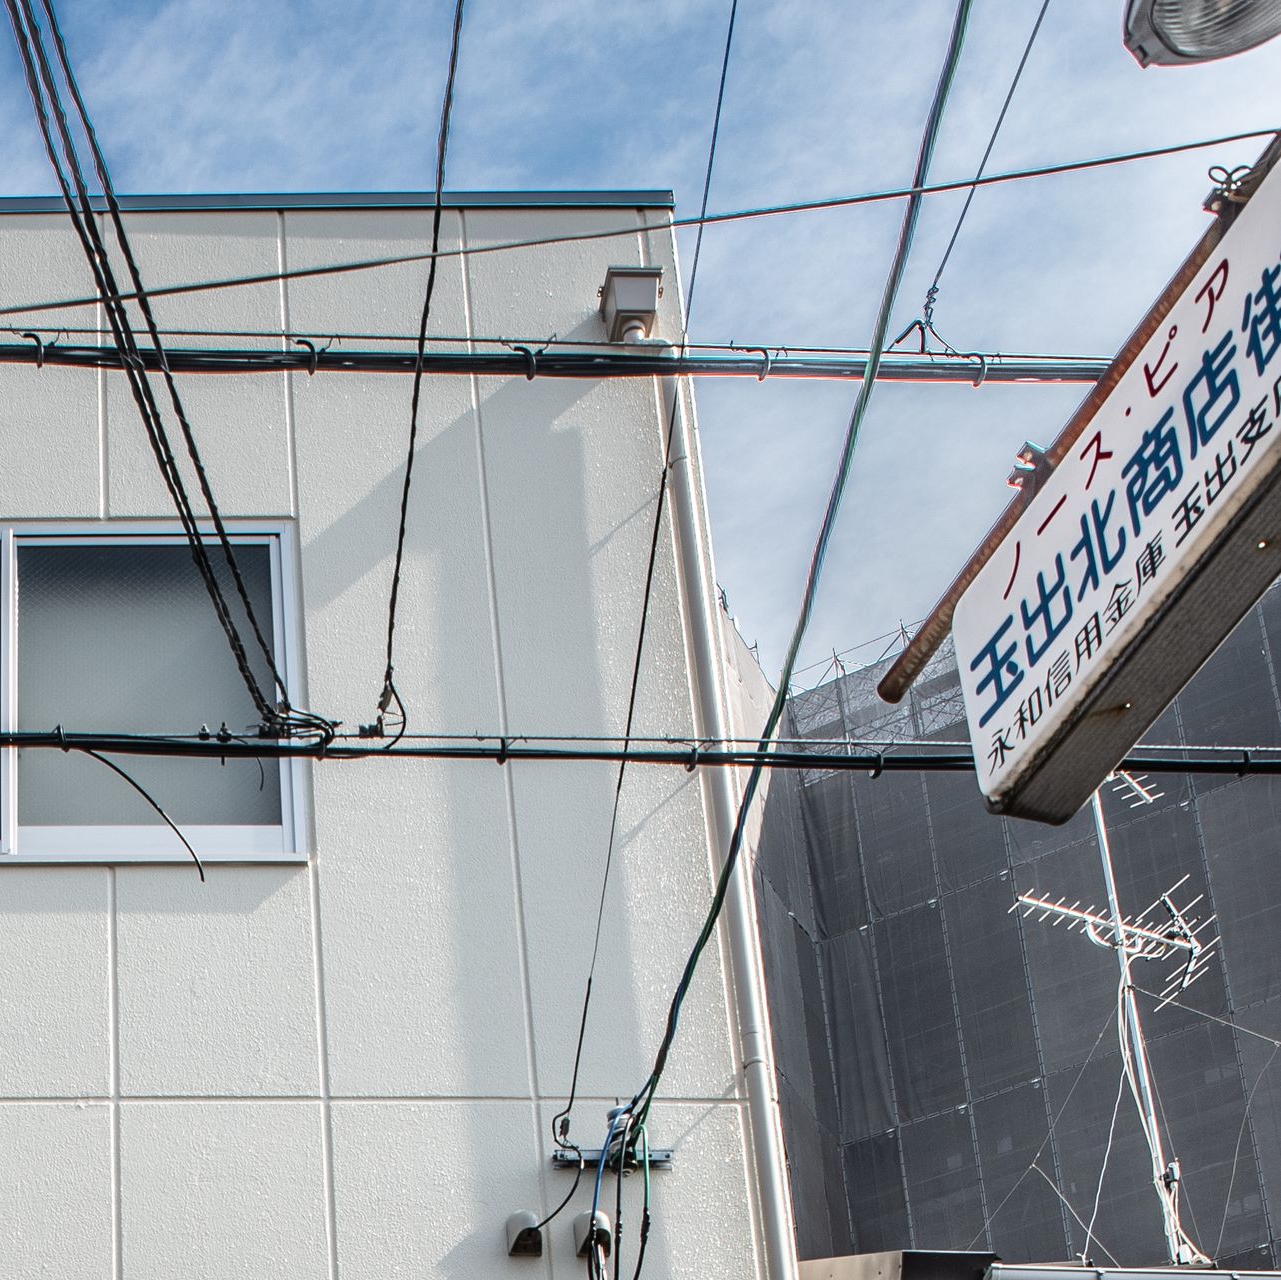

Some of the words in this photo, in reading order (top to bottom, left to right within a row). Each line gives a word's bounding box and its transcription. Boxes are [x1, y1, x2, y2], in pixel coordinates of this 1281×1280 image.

[987, 530, 1167, 777] 永和信用金庫
